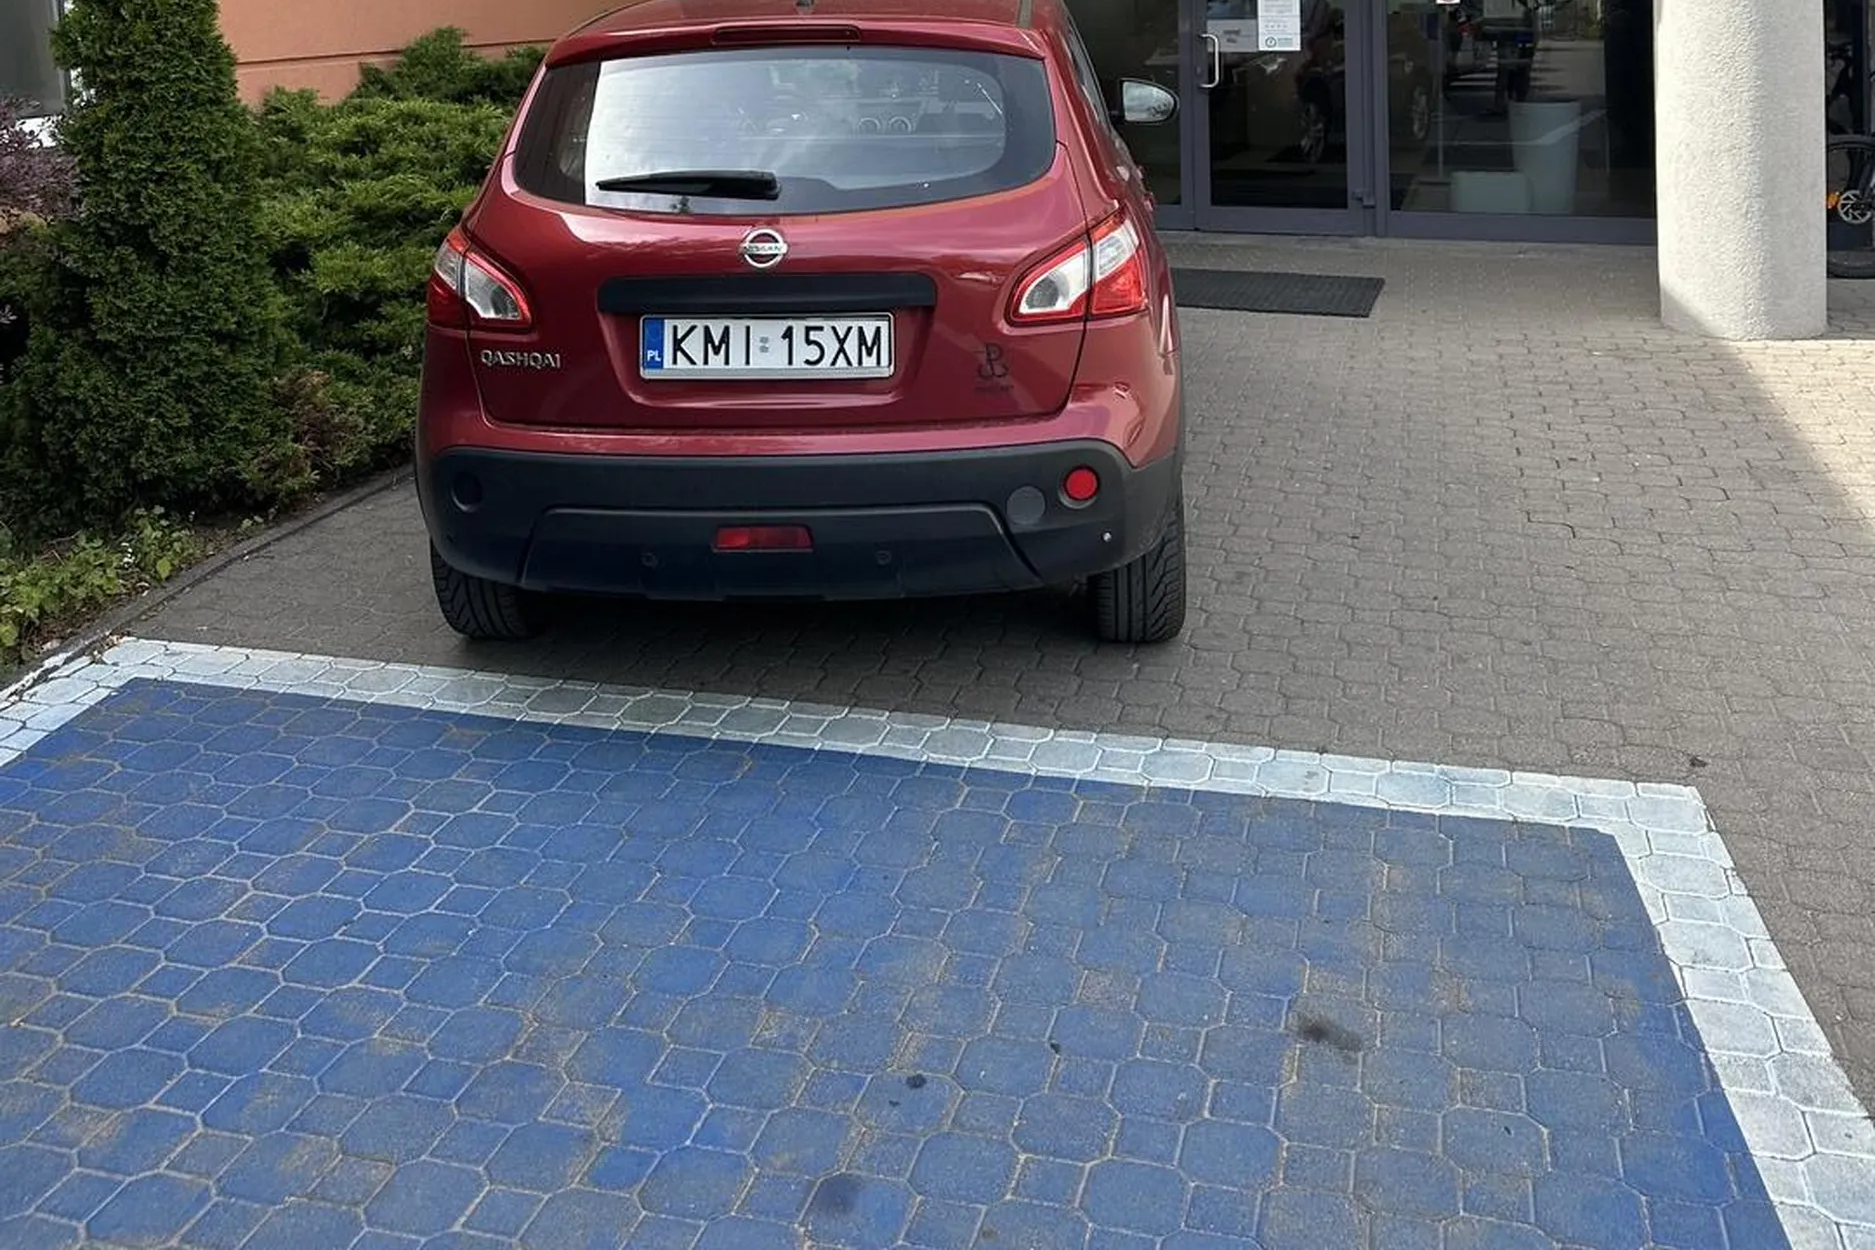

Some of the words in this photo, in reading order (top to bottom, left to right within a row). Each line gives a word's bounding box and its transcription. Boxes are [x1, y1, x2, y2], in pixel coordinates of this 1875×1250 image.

[646, 349, 662, 362] PL
[671, 324, 751, 366] KMI
[781, 324, 882, 367] 15XM
[480, 349, 561, 370] QASHQAI
